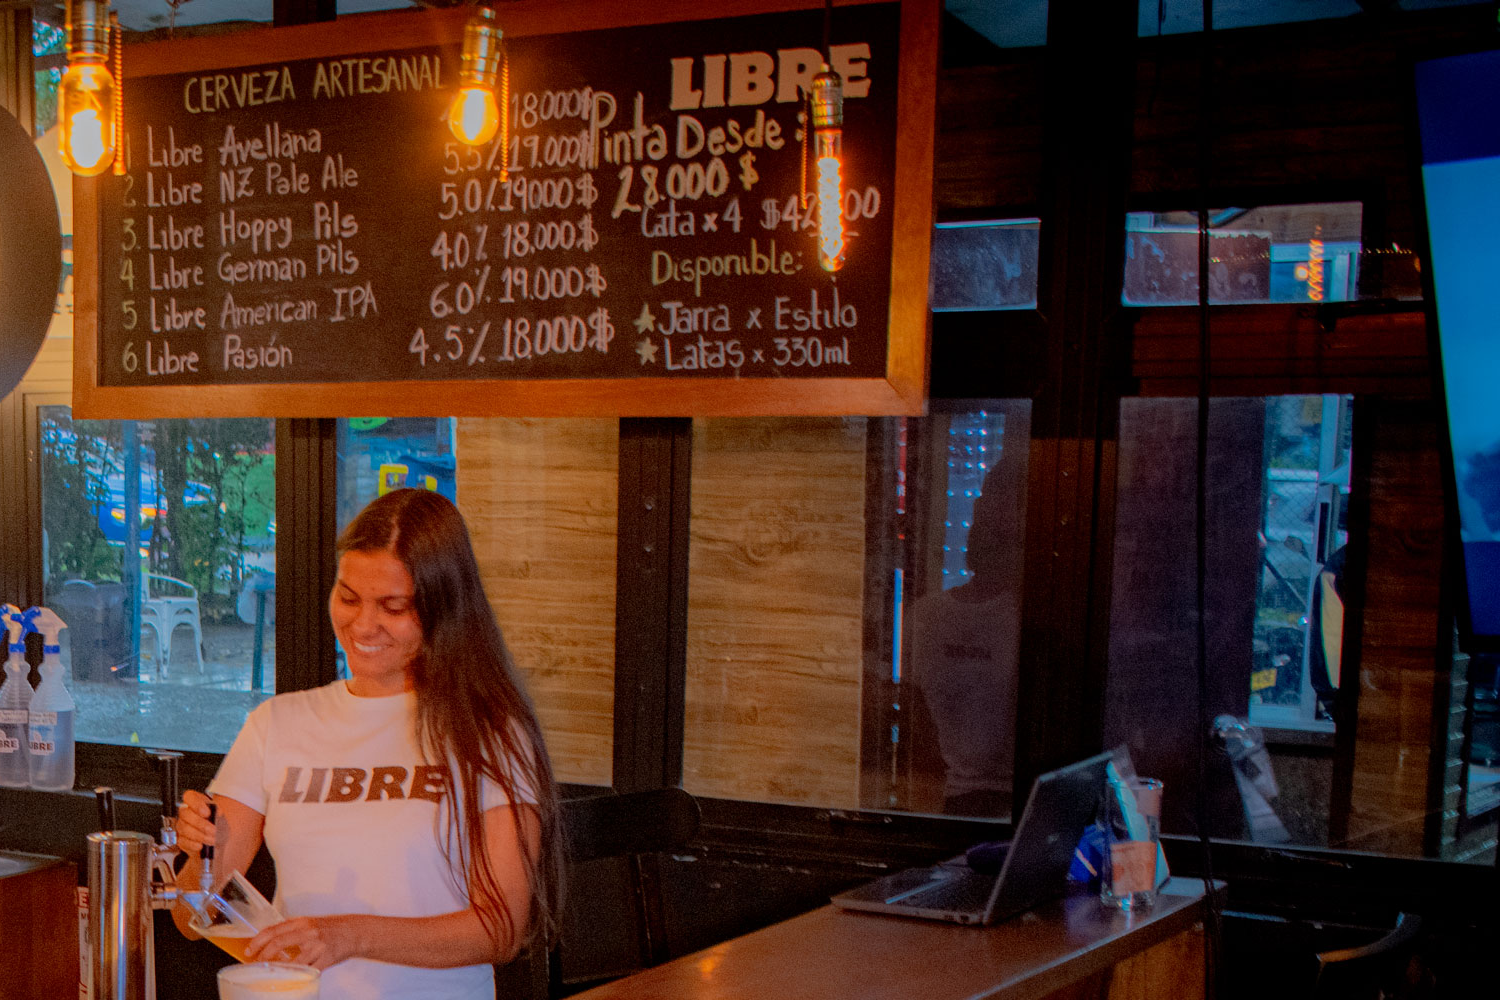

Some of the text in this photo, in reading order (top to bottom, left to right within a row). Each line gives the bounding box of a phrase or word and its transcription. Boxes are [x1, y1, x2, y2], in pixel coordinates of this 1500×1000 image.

[184, 55, 445, 114] CERVEZA ARTESANAL
[669, 43, 871, 111] LIBRE
[147, 124, 203, 167] Libre
[219, 122, 321, 166] Avellana
[590, 91, 668, 169] Pinta
[147, 171, 203, 207] Libre
[219, 168, 254, 204] NZ
[266, 162, 310, 195] Pale
[321, 154, 358, 191] Ale
[148, 215, 204, 250] Libre
[219, 209, 293, 254] Hoppy
[314, 201, 358, 240] Pils
[149, 253, 204, 290] Libre
[217, 252, 306, 285] German
[316, 239, 359, 275] Pils
[652, 238, 803, 297] Disponible:
[150, 296, 206, 333] Libre
[220, 292, 317, 329] American
[329, 281, 378, 322] IPA
[659, 301, 731, 335] Jarra
[774, 286, 858, 331] Estilo
[145, 340, 199, 375] Libre
[223, 331, 293, 371] Pasión
[772, 336, 850, 367] 330ml
[278, 765, 449, 804] LIBRE
